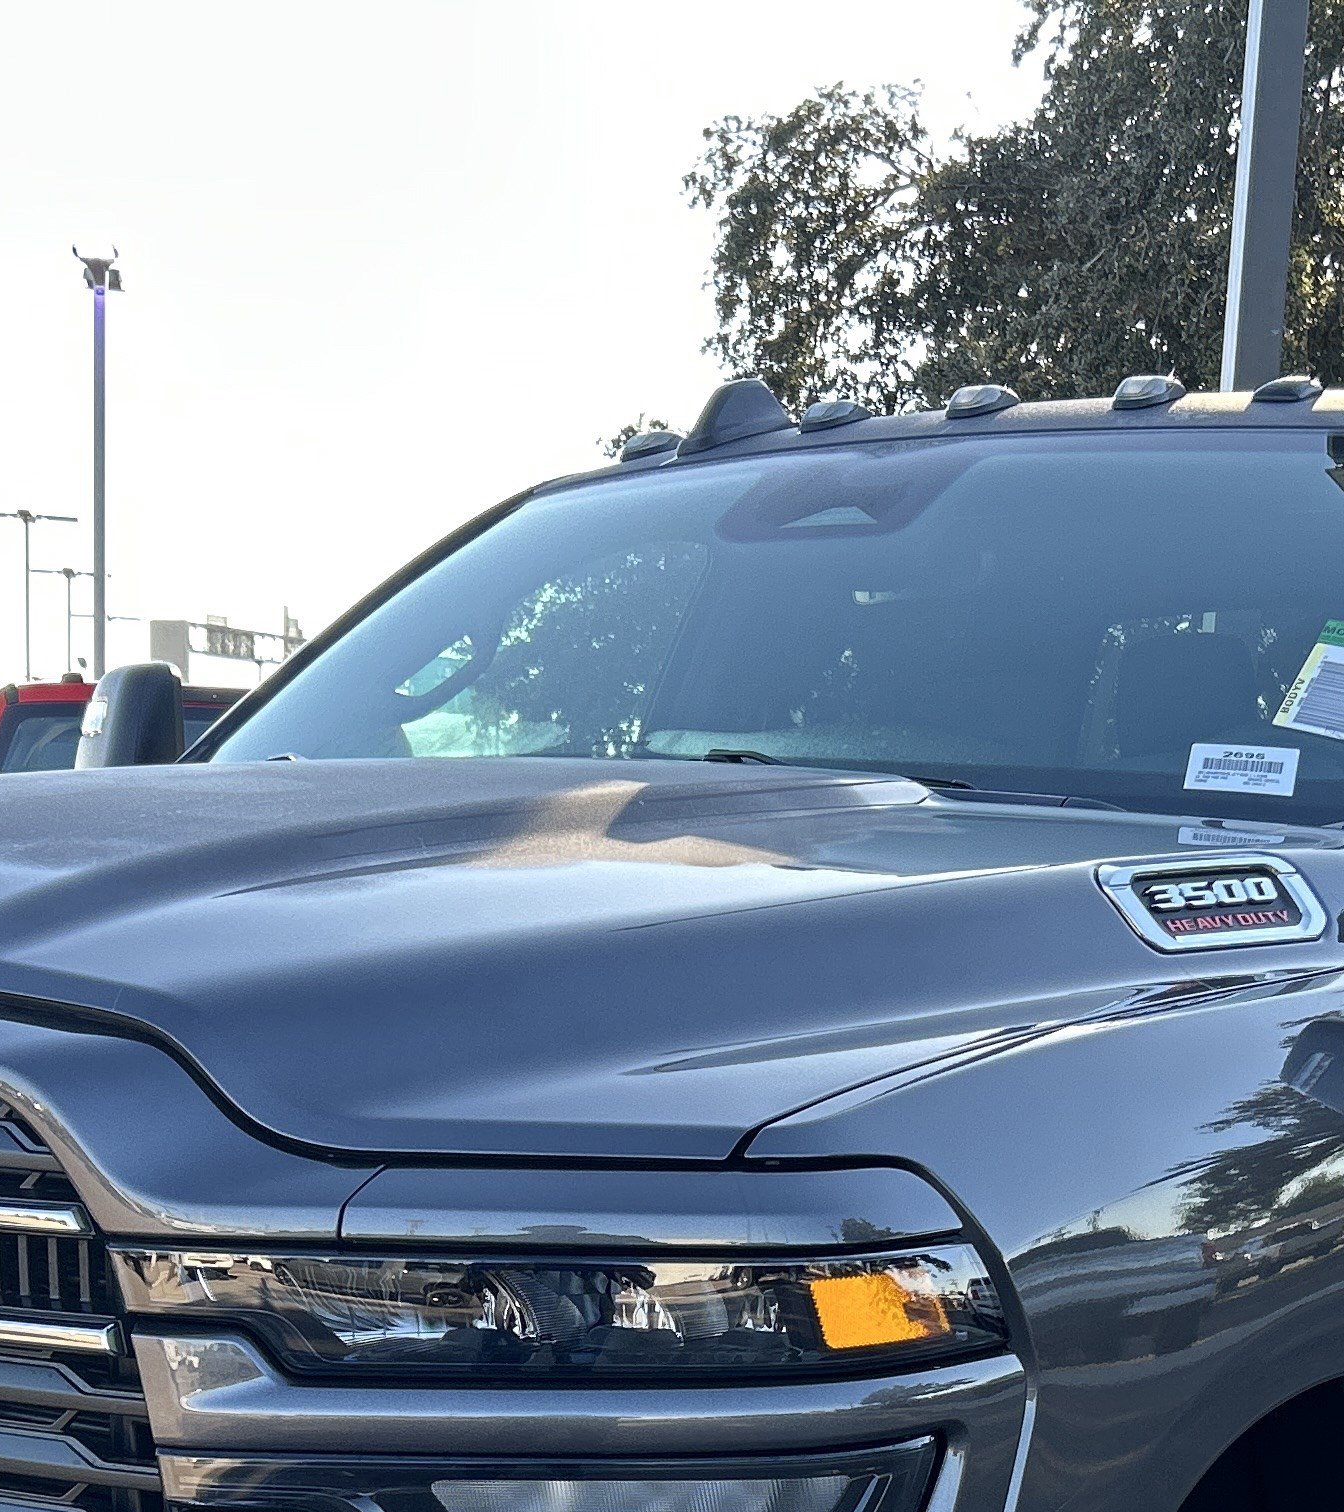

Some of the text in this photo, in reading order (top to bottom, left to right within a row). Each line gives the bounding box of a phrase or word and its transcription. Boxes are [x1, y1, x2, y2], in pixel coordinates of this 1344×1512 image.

[1144, 877, 1278, 911] 3500
[1166, 910, 1290, 932] HEAVY DUTY
